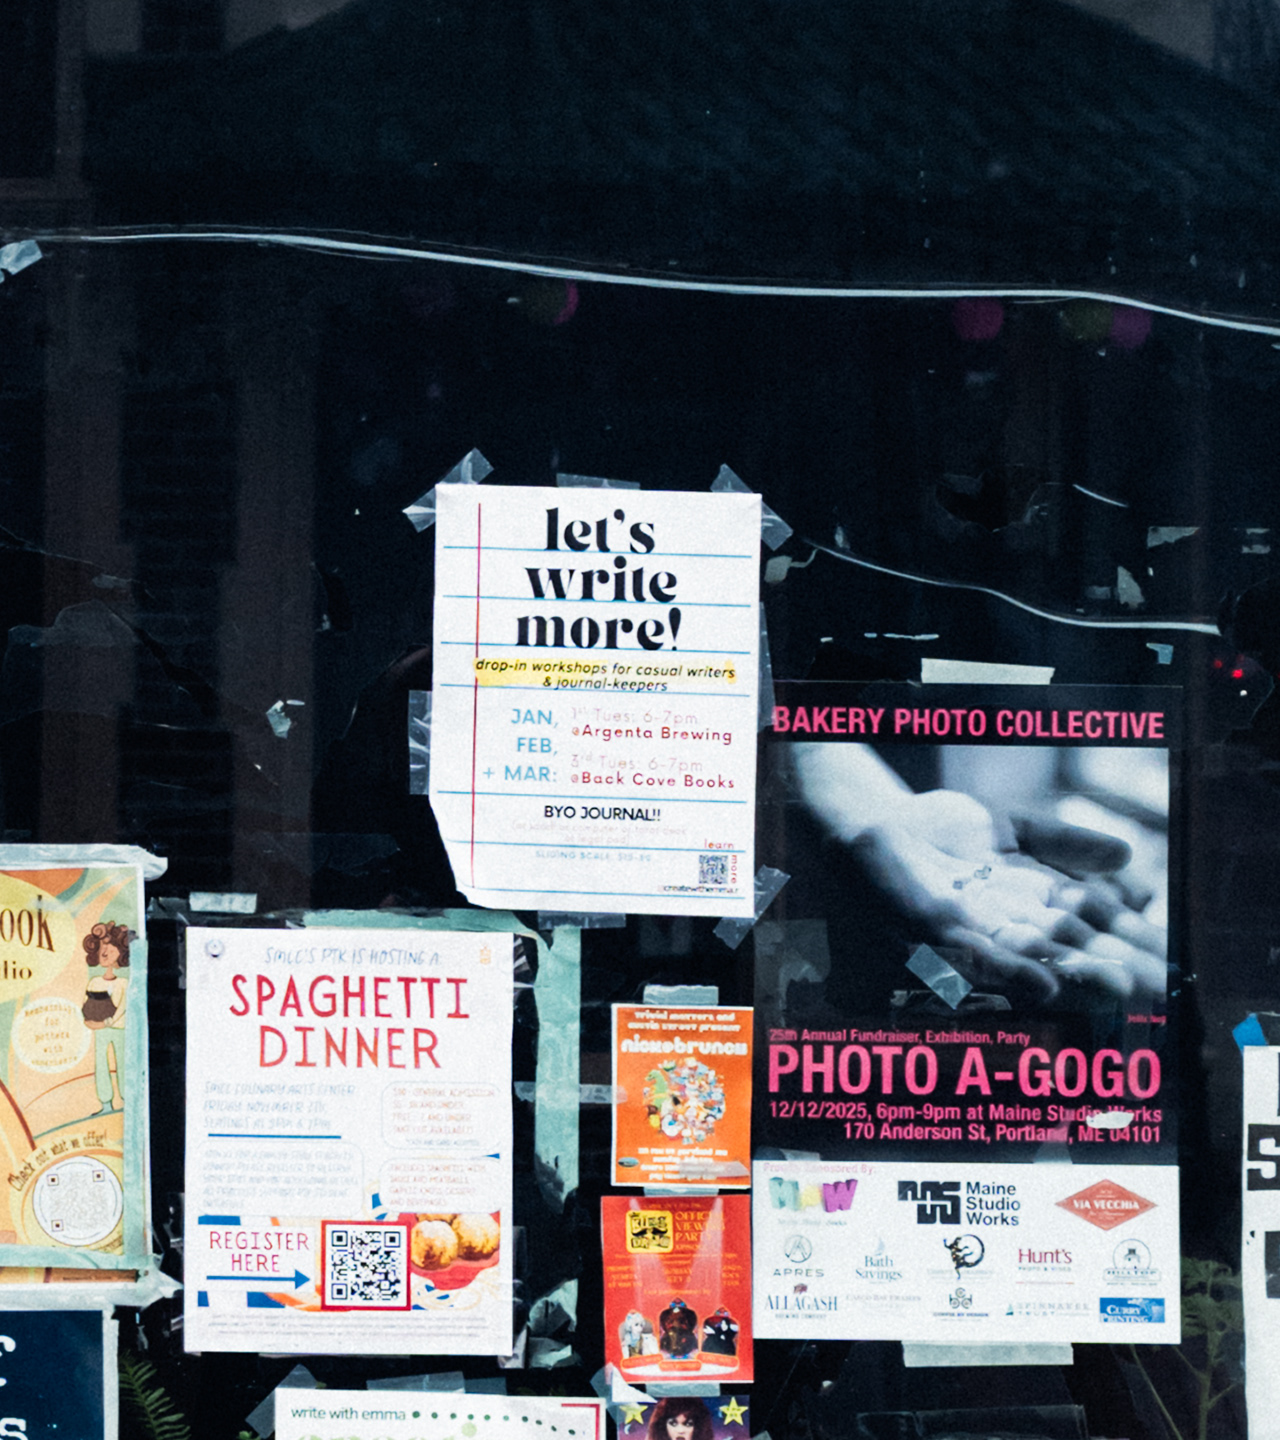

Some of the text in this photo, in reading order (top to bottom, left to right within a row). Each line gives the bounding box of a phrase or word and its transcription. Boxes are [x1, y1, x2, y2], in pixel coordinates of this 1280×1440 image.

[544, 508, 654, 554] let's
[526, 556, 676, 603] write
[516, 608, 681, 651] more!
[476, 659, 734, 678] drop-in workshops for casual writers
[553, 678, 667, 693] journal-keepers
[772, 706, 1163, 738] BAKERY PHOTO COLLECTIVE
[662, 727, 731, 745] Brewing
[633, 773, 675, 786] Cove
[685, 775, 734, 788] Books
[545, 806, 660, 821] BYO JOURNAL!!
[230, 974, 469, 1018] SPAGHETTI
[260, 1025, 440, 1068] DINNER
[801, 1029, 846, 1041] Annual
[850, 1029, 922, 1043] Fundraiser,
[926, 1031, 992, 1045] Exhibition,
[997, 1031, 1030, 1047] Party
[769, 1044, 1160, 1099] PHOTO A-GOGO
[845, 1120, 874, 1139] 170
[880, 1121, 962, 1140] Anderson
[968, 1123, 990, 1143] St,
[1079, 1126, 1105, 1142] ME
[210, 1231, 308, 1250] REGISTER
[232, 1254, 279, 1272] HERE
[1019, 1249, 1072, 1263] Hunt's
